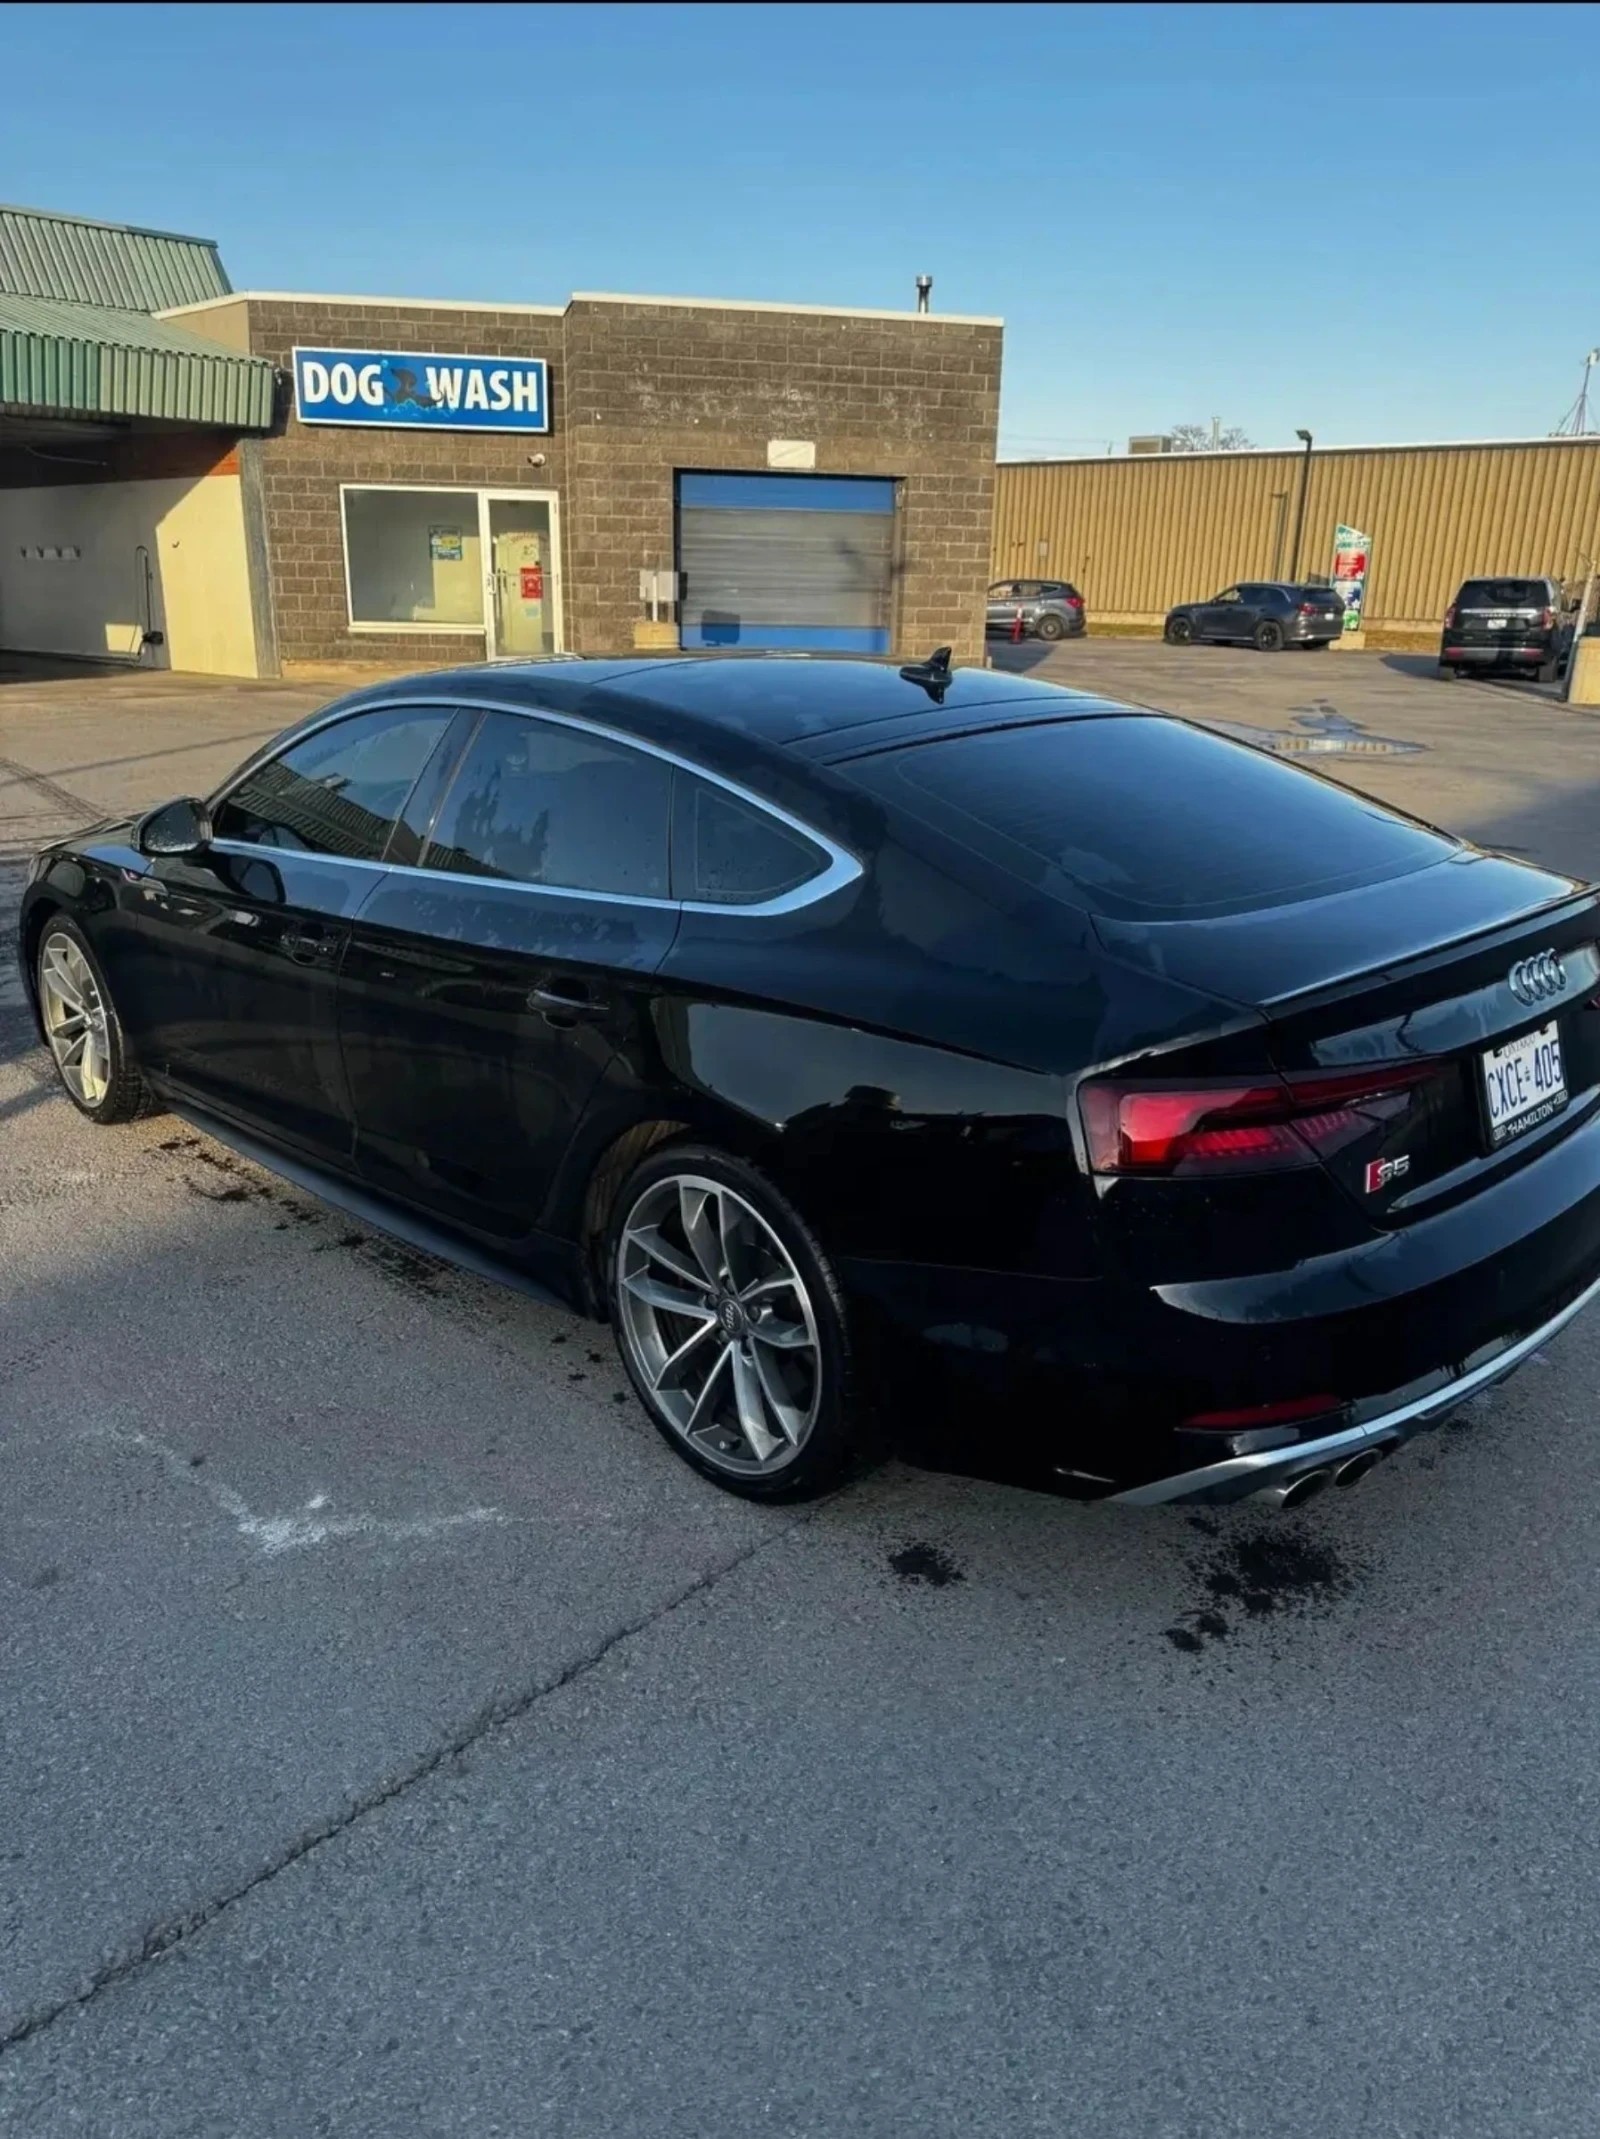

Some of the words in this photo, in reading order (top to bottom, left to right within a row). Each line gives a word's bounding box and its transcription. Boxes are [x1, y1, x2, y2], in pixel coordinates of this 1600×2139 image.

[302, 361, 384, 407] DOG
[425, 366, 539, 412] WASH
[1487, 1057, 1528, 1118] CXCE
[1534, 1040, 1562, 1092] 405
[1509, 1102, 1554, 1136] HAMILTON
[1375, 1154, 1410, 1185] S5
